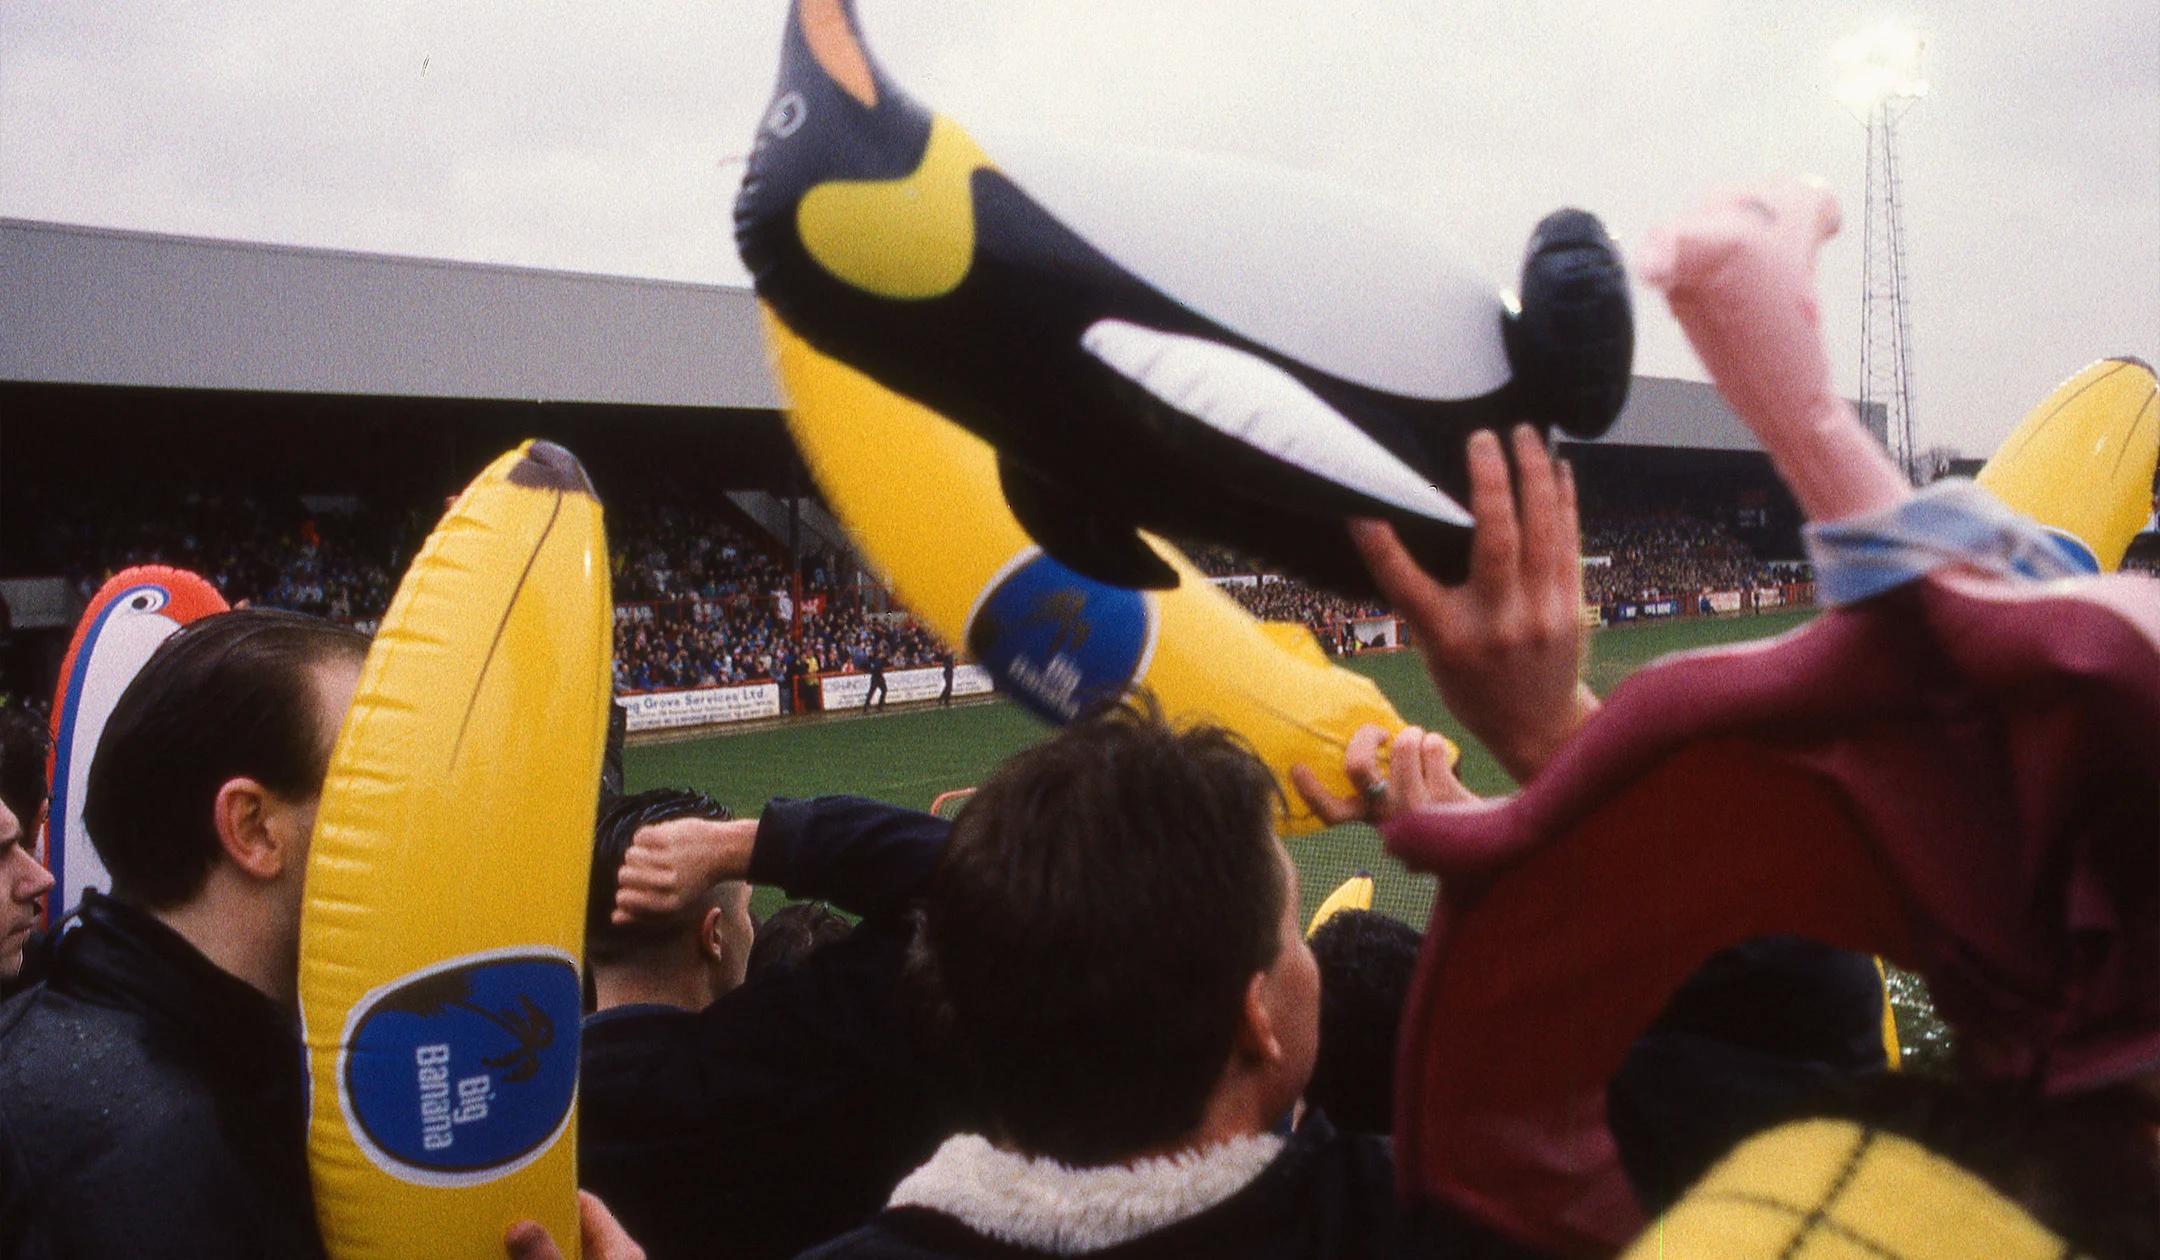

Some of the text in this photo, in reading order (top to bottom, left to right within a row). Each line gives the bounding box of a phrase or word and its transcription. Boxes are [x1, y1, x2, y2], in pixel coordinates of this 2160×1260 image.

[644, 697, 681, 709] Grove
[685, 692, 738, 705] Services
[416, 1044, 453, 1150] Banana
[453, 1075, 496, 1124] Big
